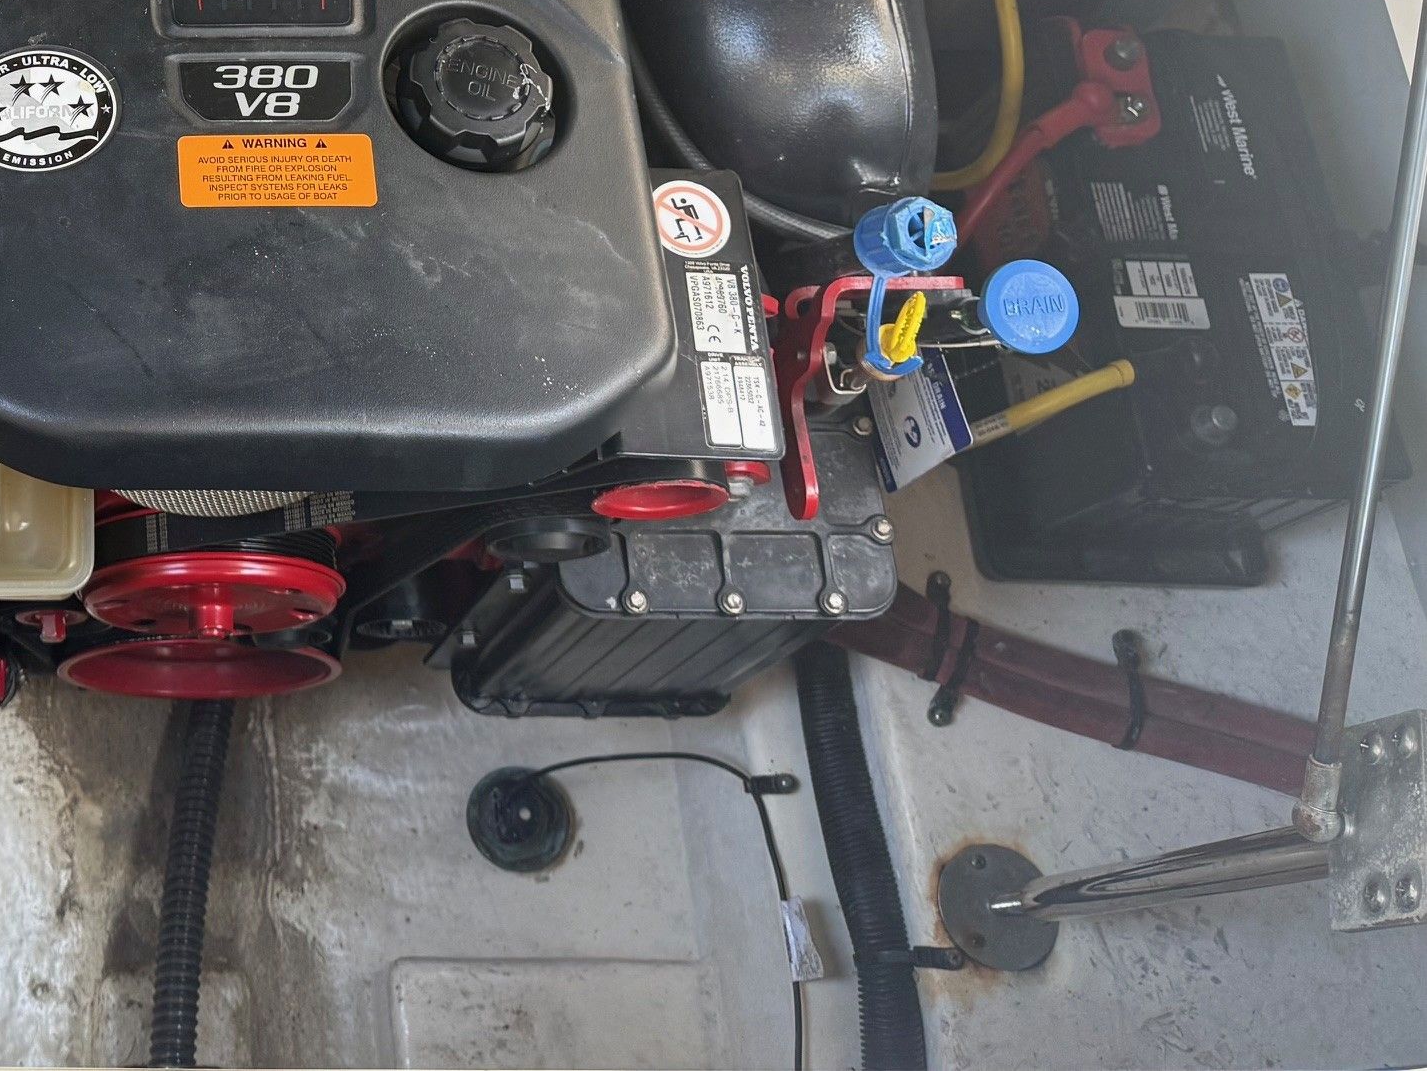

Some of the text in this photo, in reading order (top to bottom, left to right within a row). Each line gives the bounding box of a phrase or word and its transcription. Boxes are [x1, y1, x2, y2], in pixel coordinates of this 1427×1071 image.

[22, 56, 69, 70] ULTRA
[78, 67, 107, 94] LOW
[213, 65, 318, 88] 380
[448, 58, 519, 90] ENGINE
[467, 81, 496, 102] OIL
[234, 92, 301, 117] V8
[1221, 89, 1242, 124] West
[242, 138, 307, 148] WARNING
[2, 151, 74, 166] EMISSION
[702, 276, 714, 310] A971612
[727, 279, 736, 289] V8
[740, 264, 759, 350] VOLVO PENTA
[1002, 294, 1064, 316] DRAIN
[707, 325, 721, 343] CE
